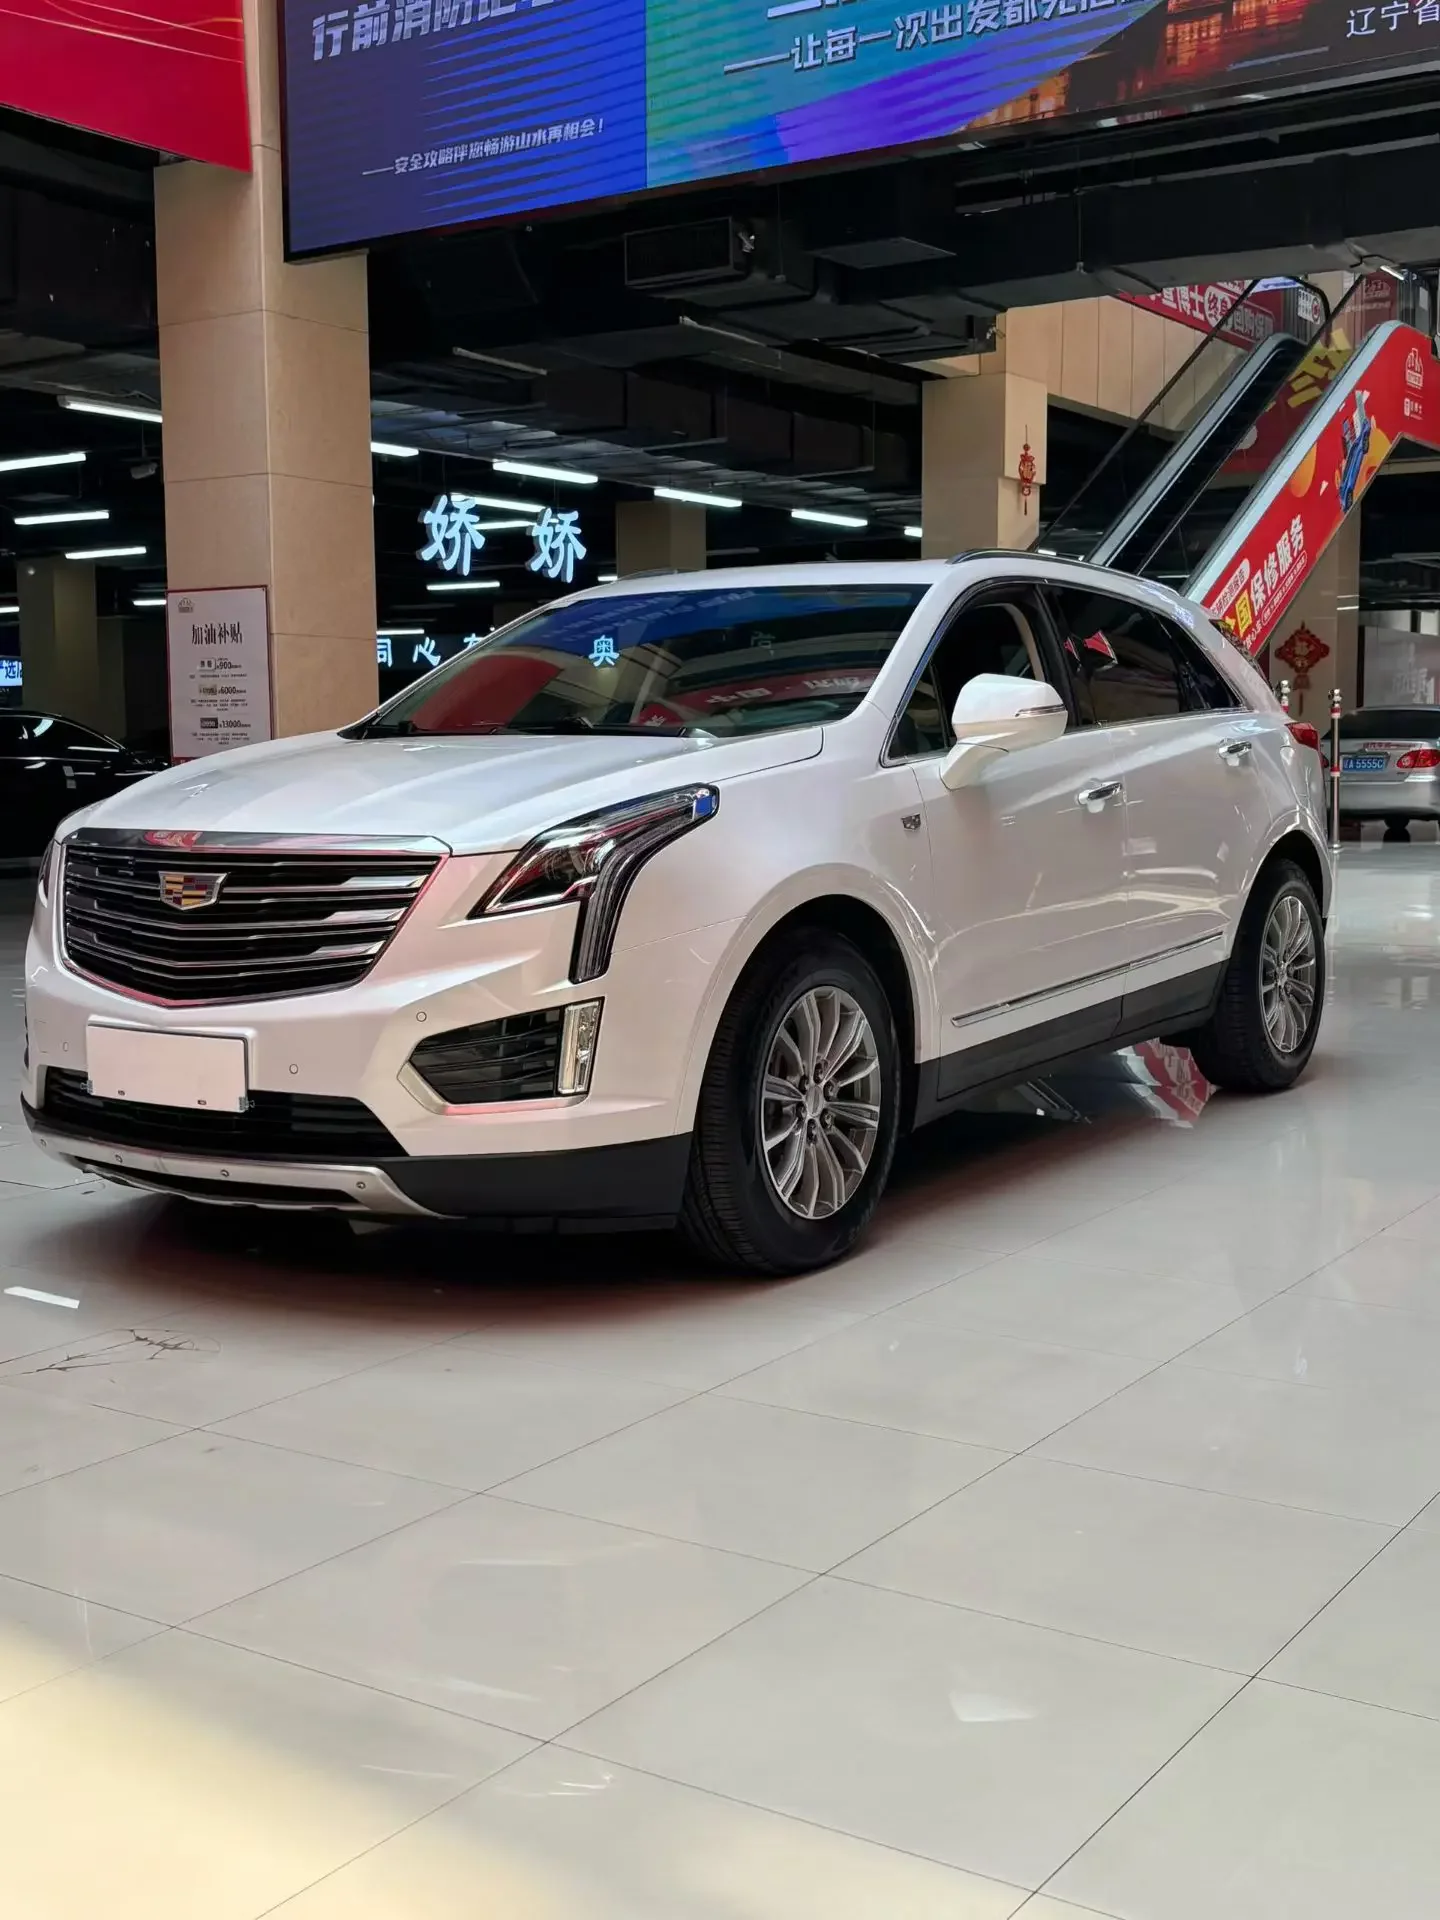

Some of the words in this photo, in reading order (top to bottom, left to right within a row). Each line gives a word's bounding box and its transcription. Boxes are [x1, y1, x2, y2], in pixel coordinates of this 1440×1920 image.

[312, 0, 556, 61] 行前消防
[1346, 0, 1440, 38] 辽宁省
[418, 494, 588, 583] 娇娇
[1218, 514, 1304, 638] 国保修服务
[191, 621, 243, 645] 加油补贴
